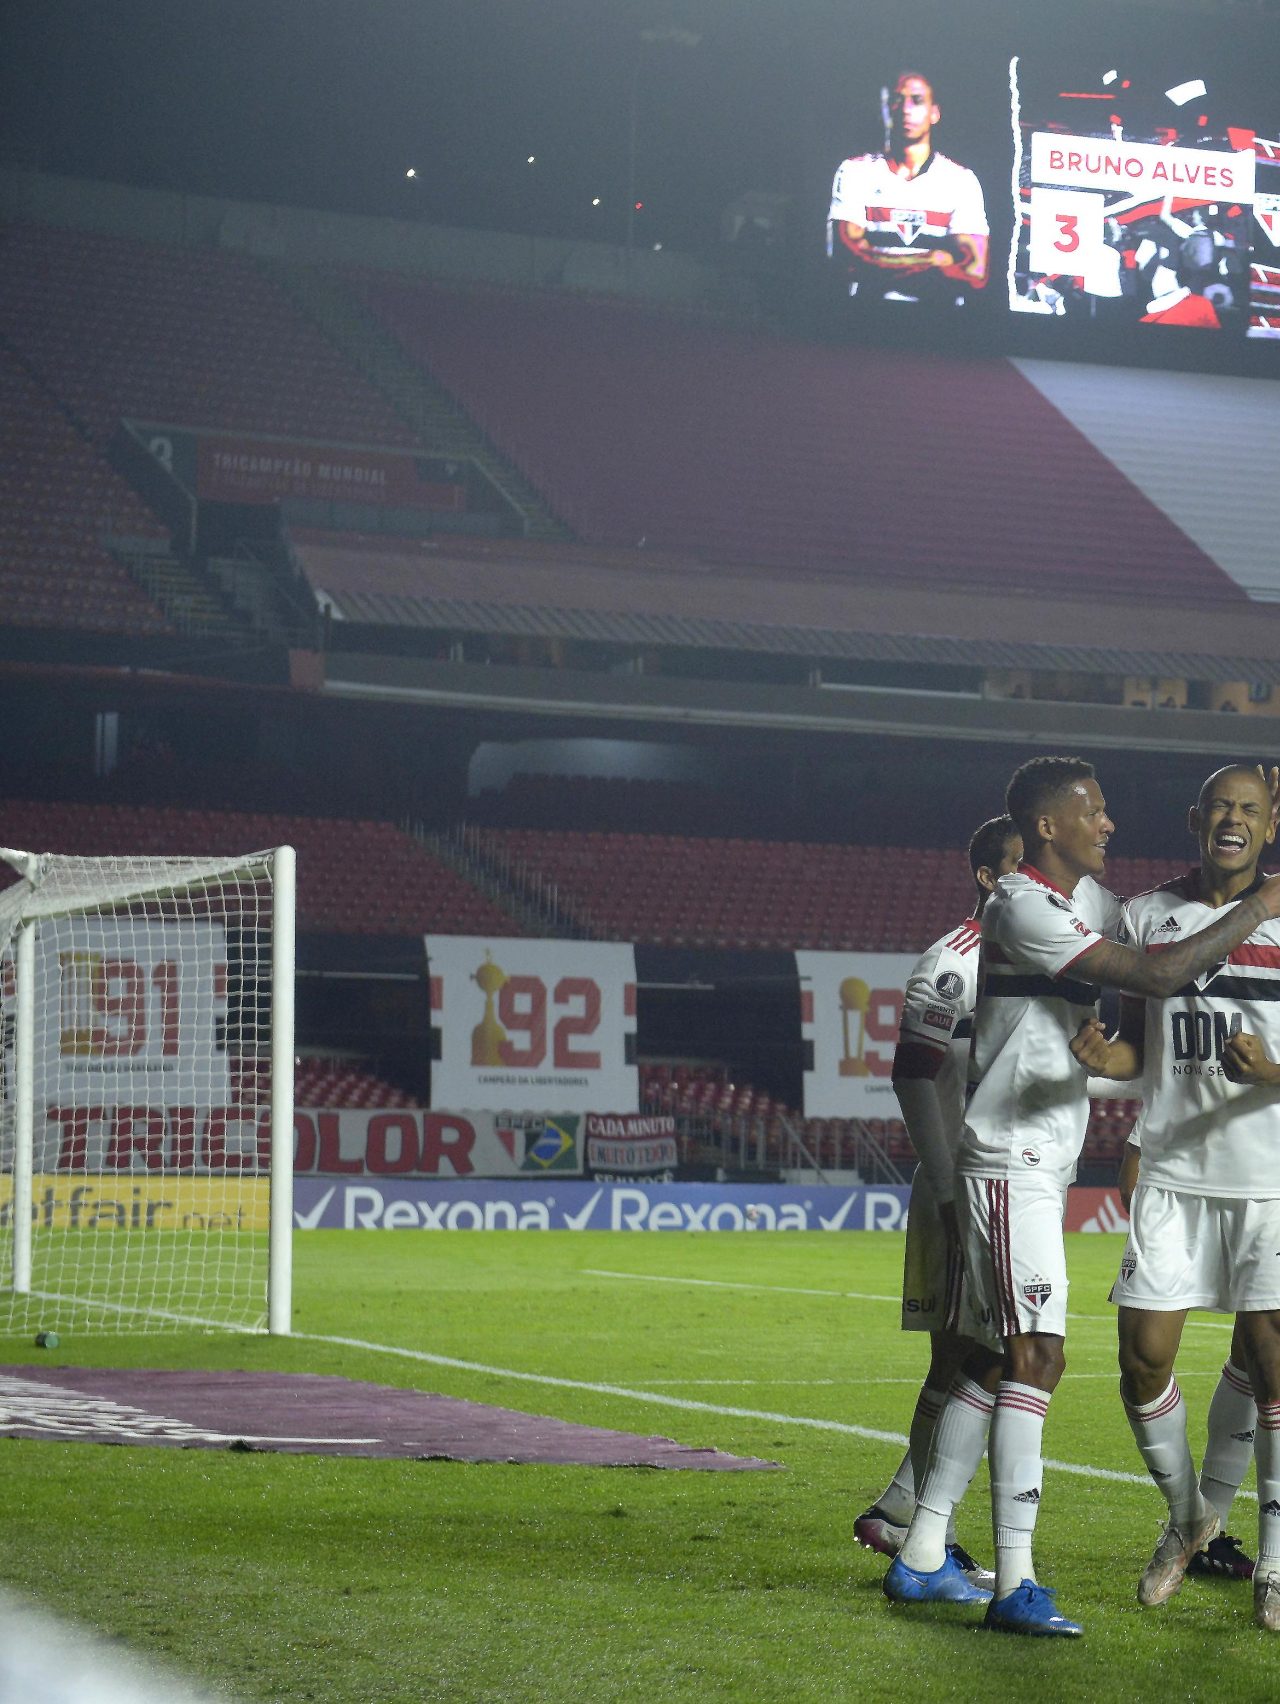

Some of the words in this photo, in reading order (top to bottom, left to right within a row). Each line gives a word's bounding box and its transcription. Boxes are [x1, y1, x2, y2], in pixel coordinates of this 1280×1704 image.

[1049, 150, 1145, 179] BRUNO
[1151, 162, 1235, 189] ALVES
[1052, 213, 1081, 253] 3
[497, 974, 602, 1070] 92
[927, 1002, 956, 1015] CIMENTO
[47, 1104, 476, 1175] TRICOLOR
[588, 1114, 625, 1137] CADA
[626, 1116, 675, 1137] MINUTO
[344, 1186, 550, 1231] Rexona
[611, 1188, 809, 1232] Rexona
[1024, 1284, 1052, 1293] SPFC
